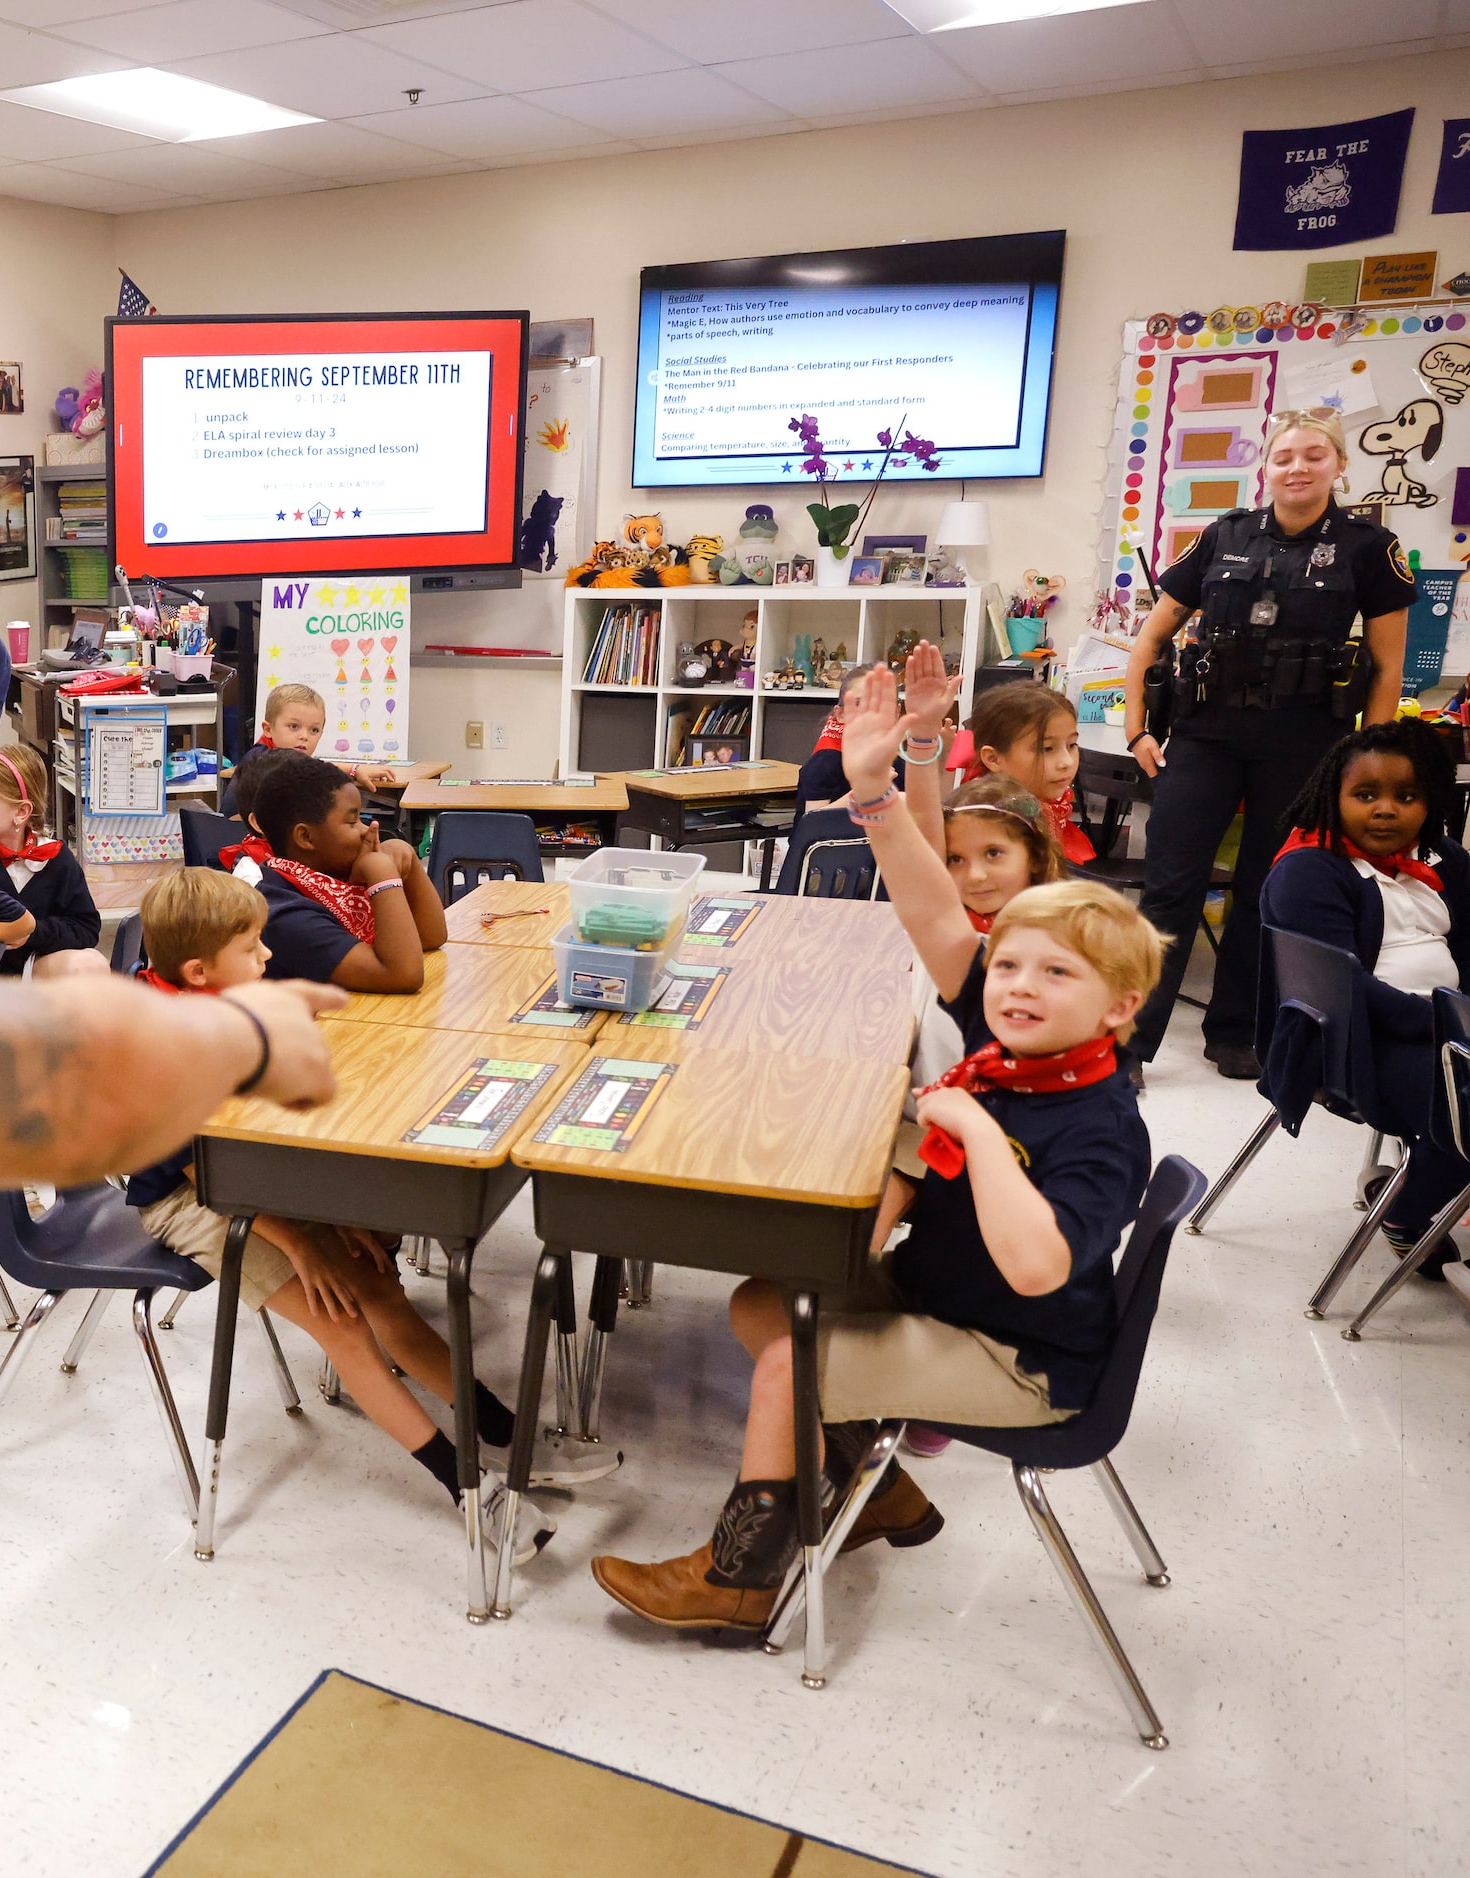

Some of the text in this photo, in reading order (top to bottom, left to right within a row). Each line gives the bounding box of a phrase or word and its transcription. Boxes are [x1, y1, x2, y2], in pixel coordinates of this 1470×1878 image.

[1284, 139, 1370, 164] FEAR THE
[1297, 215, 1337, 231] FROG
[668, 293, 705, 303] Reading
[667, 300, 789, 316] Mentor Text: This Very Tree
[699, 318, 707, 327] E,
[709, 316, 729, 325] How
[730, 314, 765, 324] authors
[767, 313, 783, 321] use
[785, 311, 824, 320] emotion
[826, 308, 844, 317] and
[846, 304, 900, 316] vocabulary
[902, 303, 912, 312] to
[914, 302, 951, 312] convey
[953, 299, 978, 309] deep
[980, 295, 1026, 307] meaning
[695, 330, 704, 339] of
[706, 328, 740, 340] speech,
[742, 326, 774, 336] writing
[665, 355, 727, 366] Social Studies
[665, 370, 680, 378] The
[682, 369, 701, 377] Man
[703, 368, 712, 376] in
[714, 367, 728, 375] the
[730, 366, 747, 374] Red
[749, 364, 789, 373] Bandana
[797, 359, 851, 371] Celebrating
[872, 357, 894, 366] First
[895, 354, 954, 366] Responders
[185, 364, 460, 389] REMEMBERING SEPTEMBER 11TH
[717, 380, 736, 388] 9/11
[295, 393, 346, 404] 9-11-24
[664, 395, 686, 403] Math
[700, 405, 714, 414] 2-4
[715, 405, 735, 415] digit
[737, 402, 777, 411] numbers
[779, 402, 788, 410] in
[789, 400, 835, 410] expanded
[837, 399, 855, 407] and
[857, 397, 899, 406] standard
[902, 396, 925, 404] form
[206, 411, 248, 424] unpack
[204, 427, 336, 442] ELA spiral review day 3
[662, 432, 695, 440] Science
[203, 442, 419, 459] Dreambox (check for assigned lesson)
[661, 442, 708, 453] Comparing
[710, 440, 768, 451] temperature,
[770, 440, 790, 449] size,
[823, 437, 851, 447] antity
[273, 583, 310, 610] MY
[305, 611, 404, 635] COLORING
